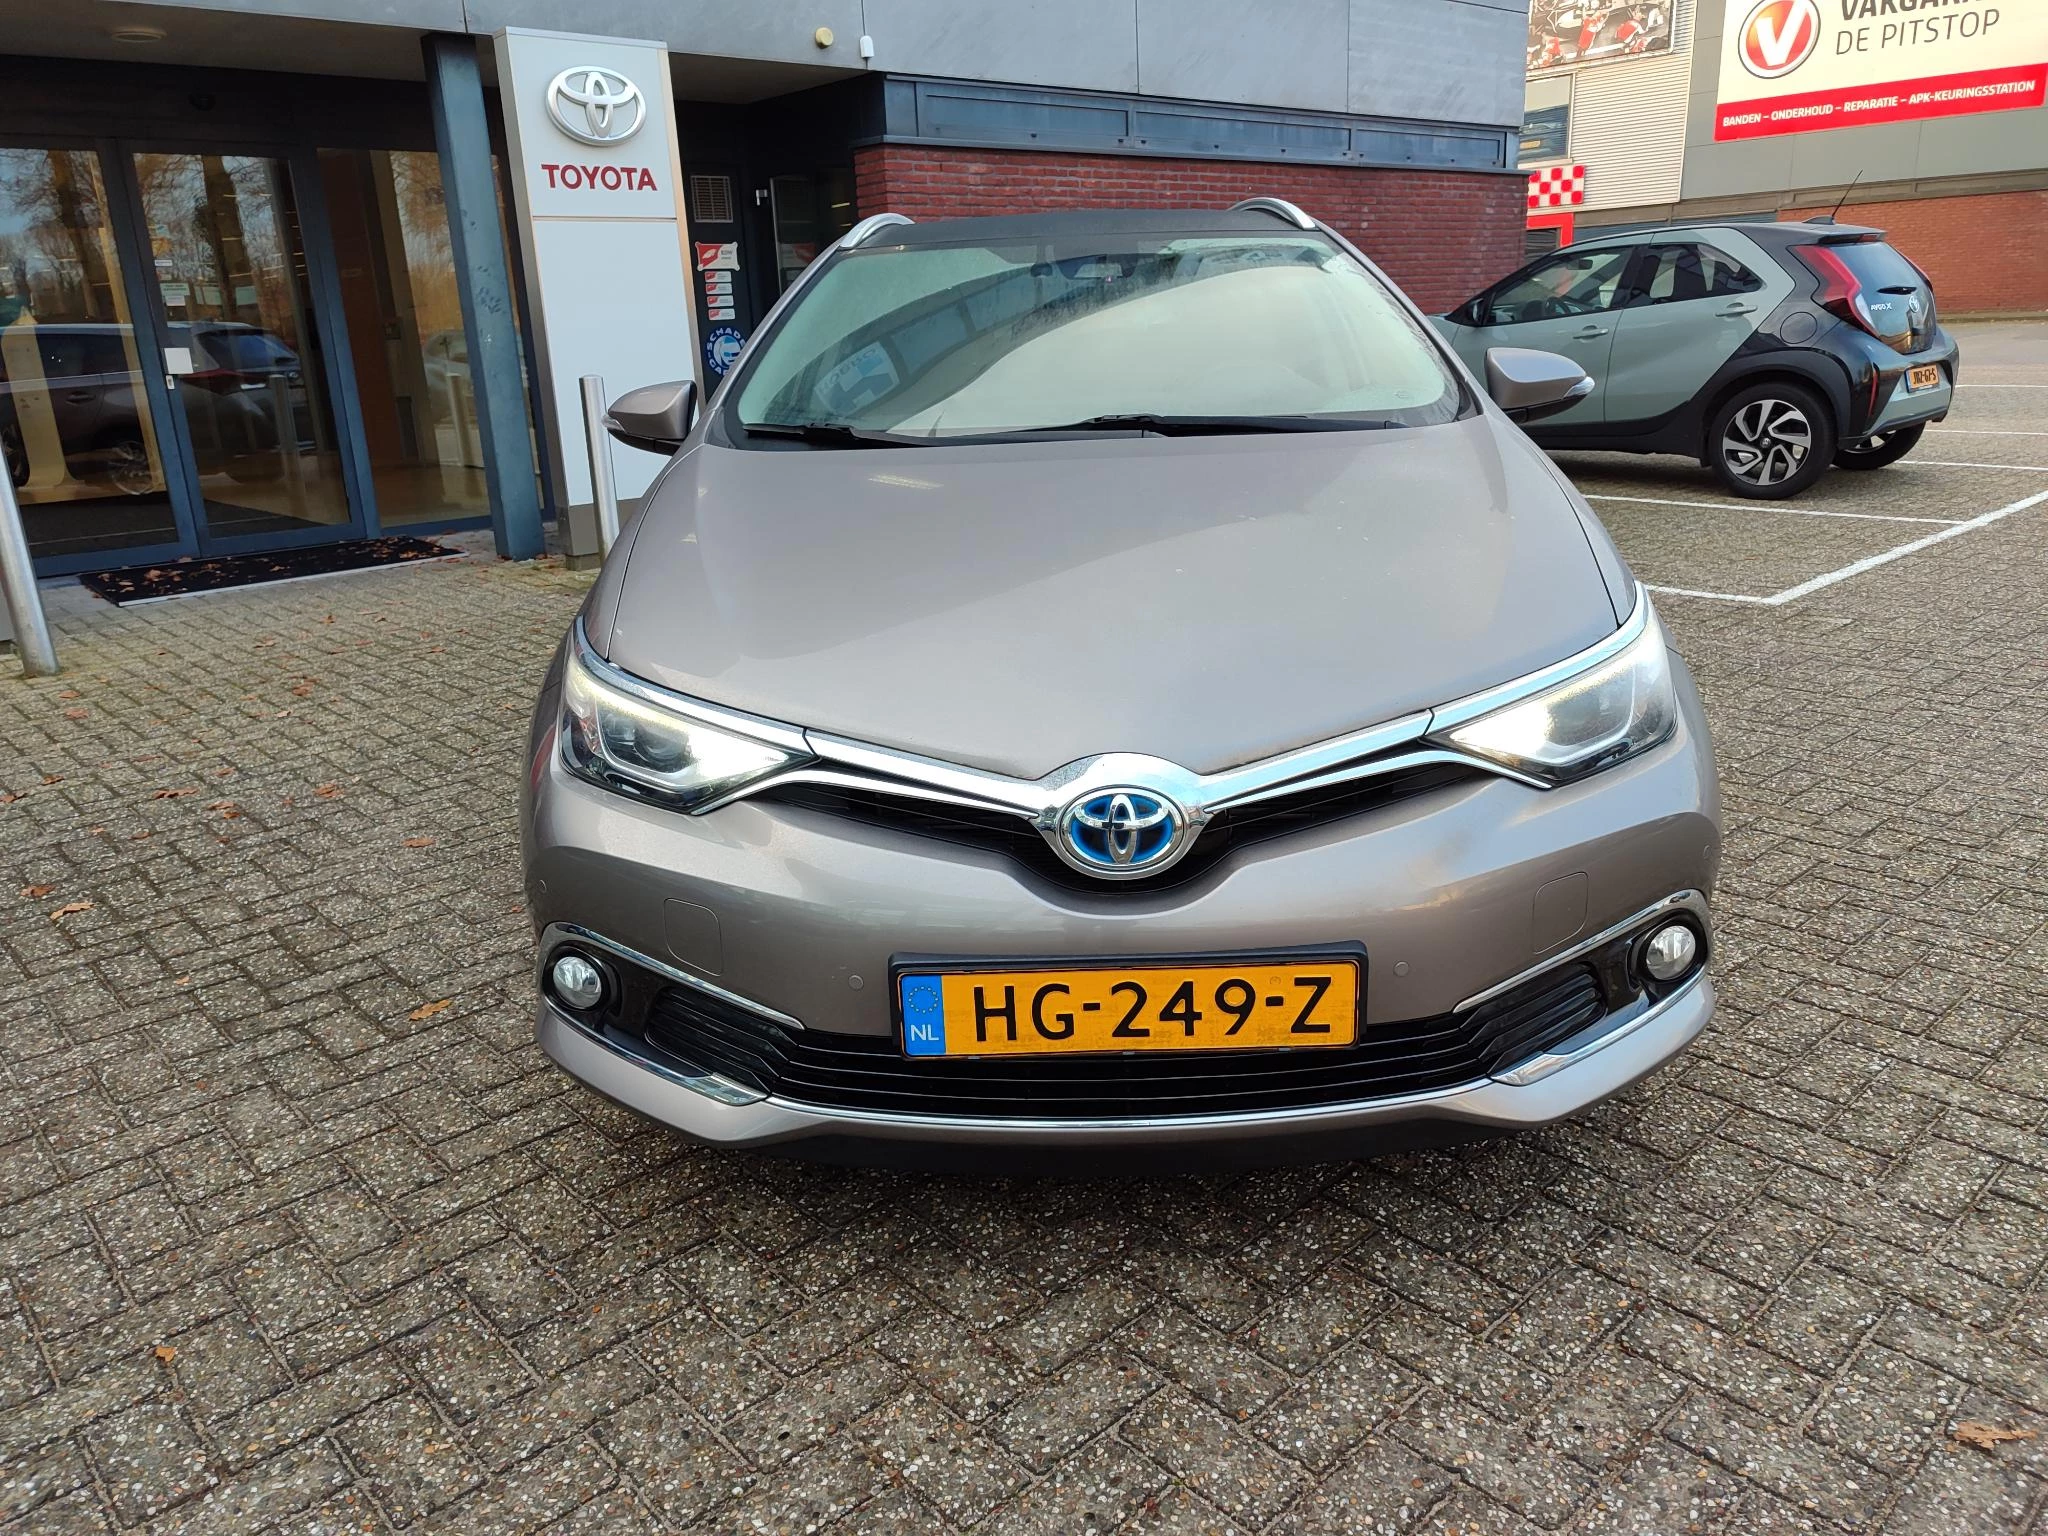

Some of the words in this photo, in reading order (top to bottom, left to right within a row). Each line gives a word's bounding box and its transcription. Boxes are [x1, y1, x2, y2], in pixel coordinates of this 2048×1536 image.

[1836, 27, 1870, 55] DE
[1881, 8, 2000, 49] PITSTOP
[1722, 113, 1761, 127] BANDEN
[1771, 104, 1833, 121] ONDERHOUD
[1843, 96, 1899, 112] REPARATIE
[1908, 80, 2036, 105] APK-KEURINGSSTATION
[541, 164, 658, 191] TOYOTA
[910, 1024, 940, 1042] NL
[972, 976, 1333, 1042] HG-249-Z
